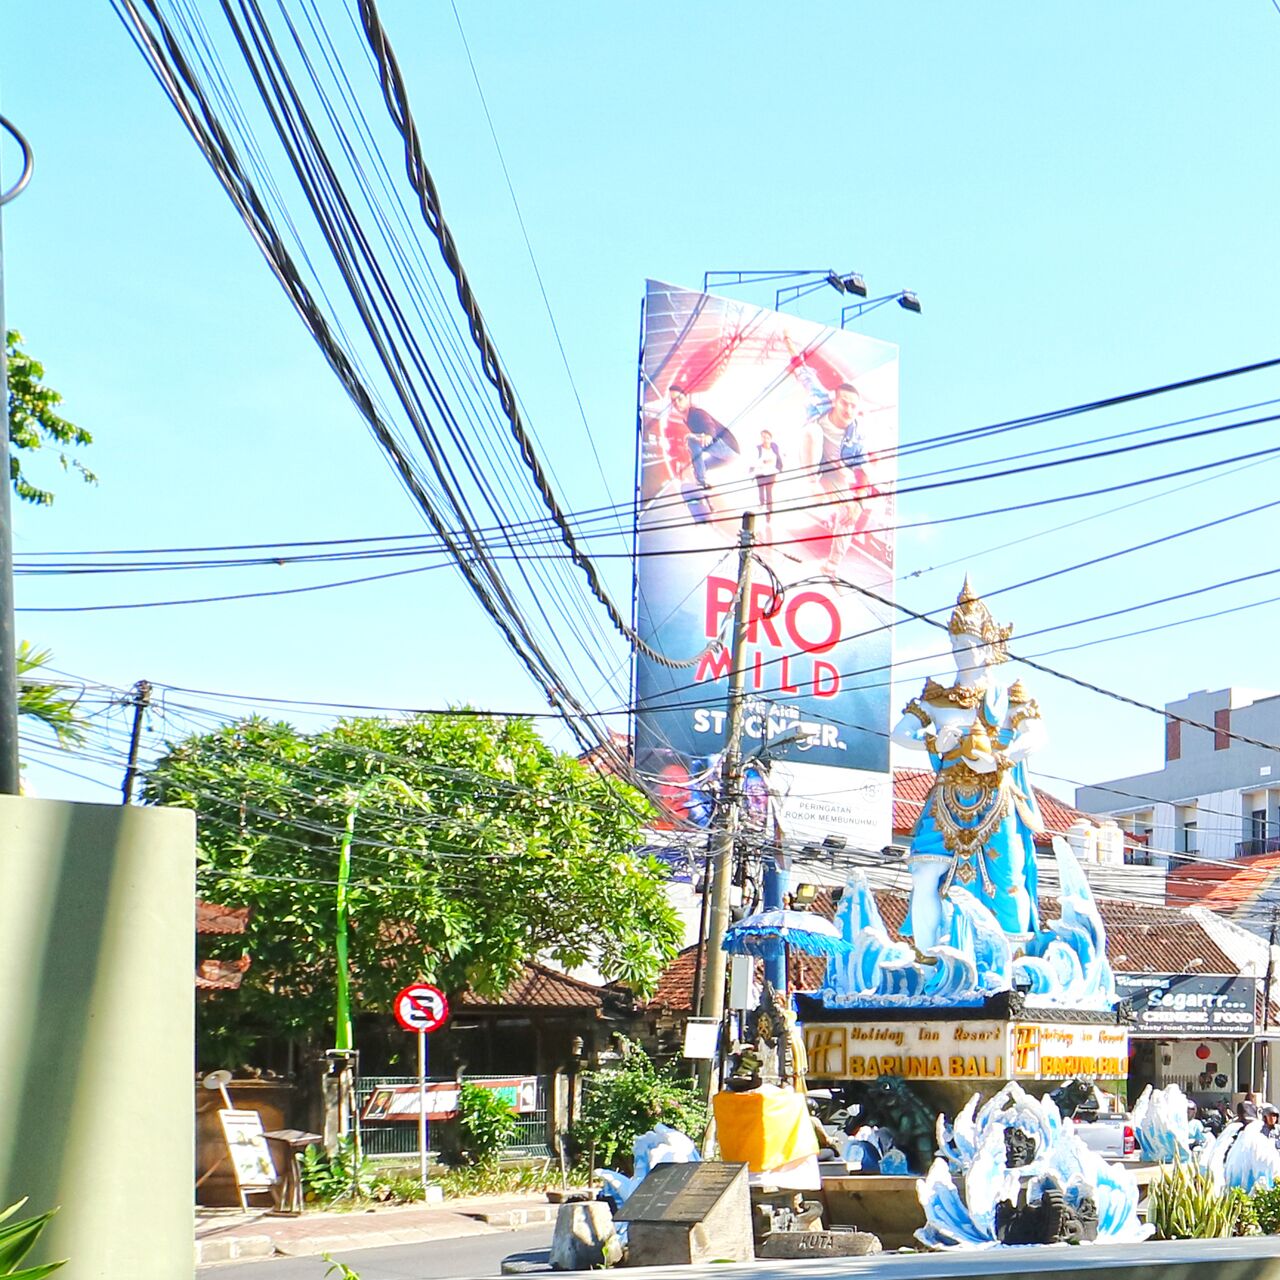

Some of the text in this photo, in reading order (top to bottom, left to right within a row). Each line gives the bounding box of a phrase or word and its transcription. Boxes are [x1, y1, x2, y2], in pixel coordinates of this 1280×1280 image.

[705, 575, 842, 655] PRO
[694, 646, 841, 698] MILD
[768, 702, 800, 719] ARE
[693, 708, 848, 752] STONER.
[799, 801, 852, 814] PERINGATAN
[785, 811, 879, 827] ROKOK MEMBUNUHMU
[1142, 1010, 1209, 1023] CHINESE
[1213, 1011, 1254, 1023] FOOD
[851, 1025, 1001, 1046] Holiday Inn Resort
[1138, 1024, 1162, 1032] Tasty
[850, 1056, 1001, 1077] BARUNA BALI
[1040, 1055, 1129, 1076] BARUNA BALI
[799, 1235, 835, 1250] KUTA
